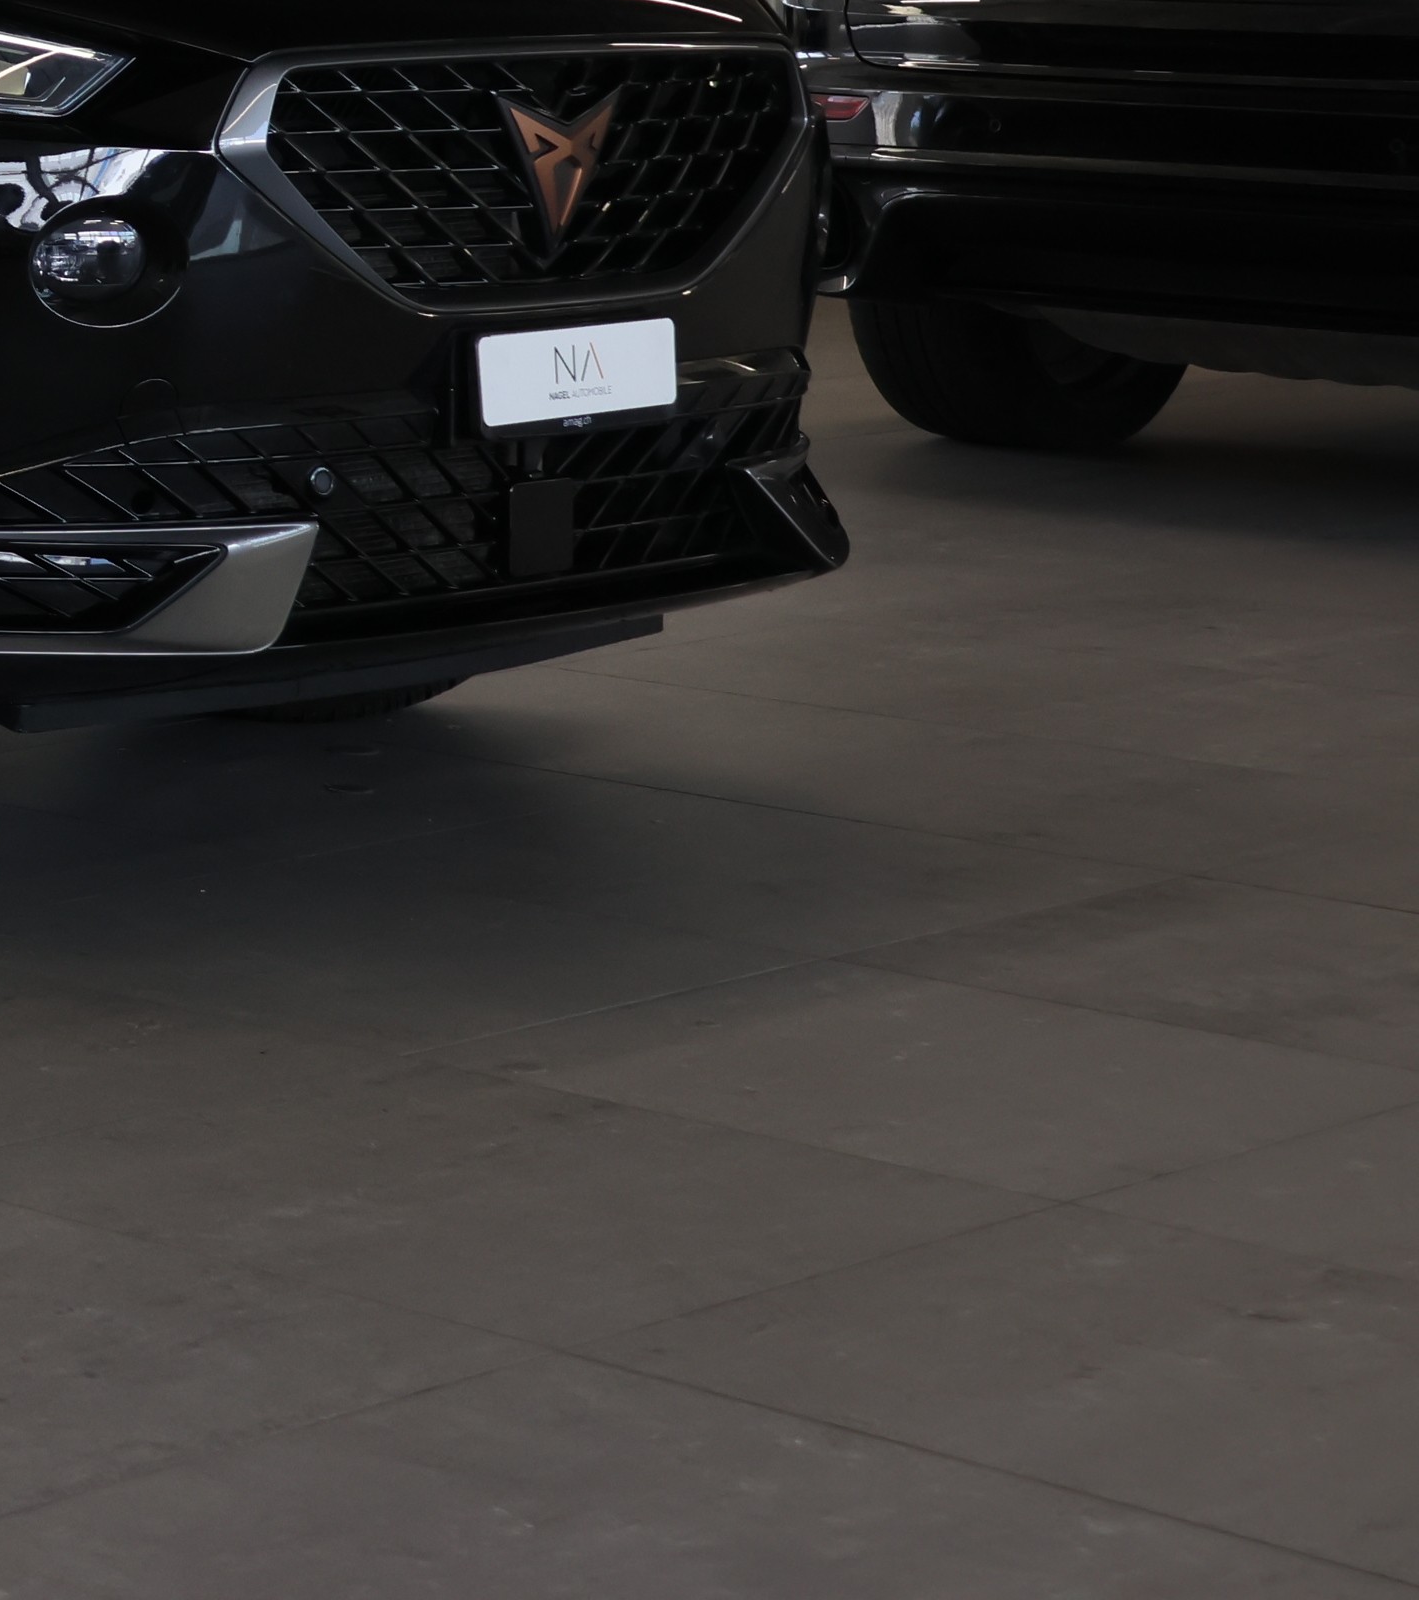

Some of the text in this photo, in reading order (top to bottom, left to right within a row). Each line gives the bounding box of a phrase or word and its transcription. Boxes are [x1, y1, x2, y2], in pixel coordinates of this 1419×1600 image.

[549, 385, 612, 401] NAGEL AUTOMOBILE
[563, 414, 592, 428] amag.ch
